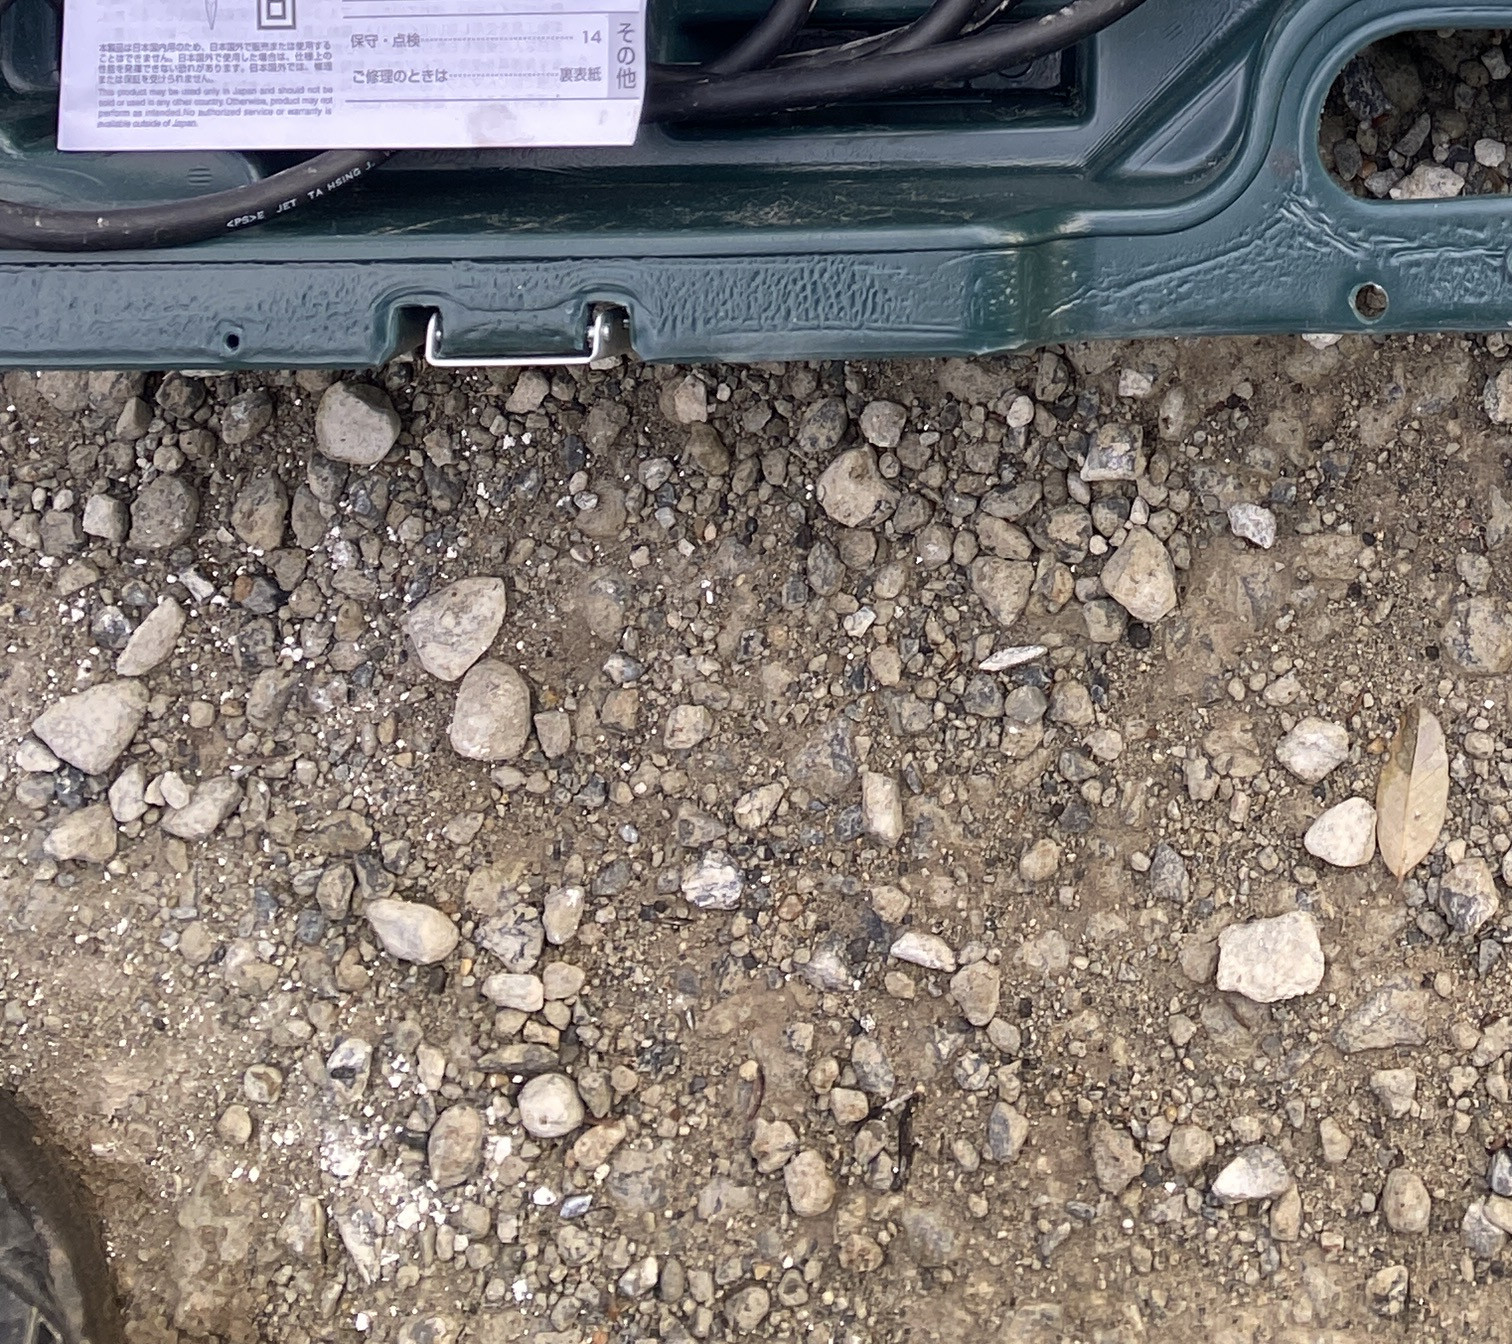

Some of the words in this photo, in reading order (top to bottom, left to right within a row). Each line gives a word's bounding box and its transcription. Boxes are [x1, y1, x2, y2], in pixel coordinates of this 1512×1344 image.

[582, 30, 602, 44] 14
[616, 22, 637, 90] その他
[352, 69, 449, 84] ご修理のときは
[559, 66, 602, 82] 裏表紙
[276, 198, 297, 213] JET
[307, 188, 323, 200] TA
[327, 167, 361, 192] HSING
